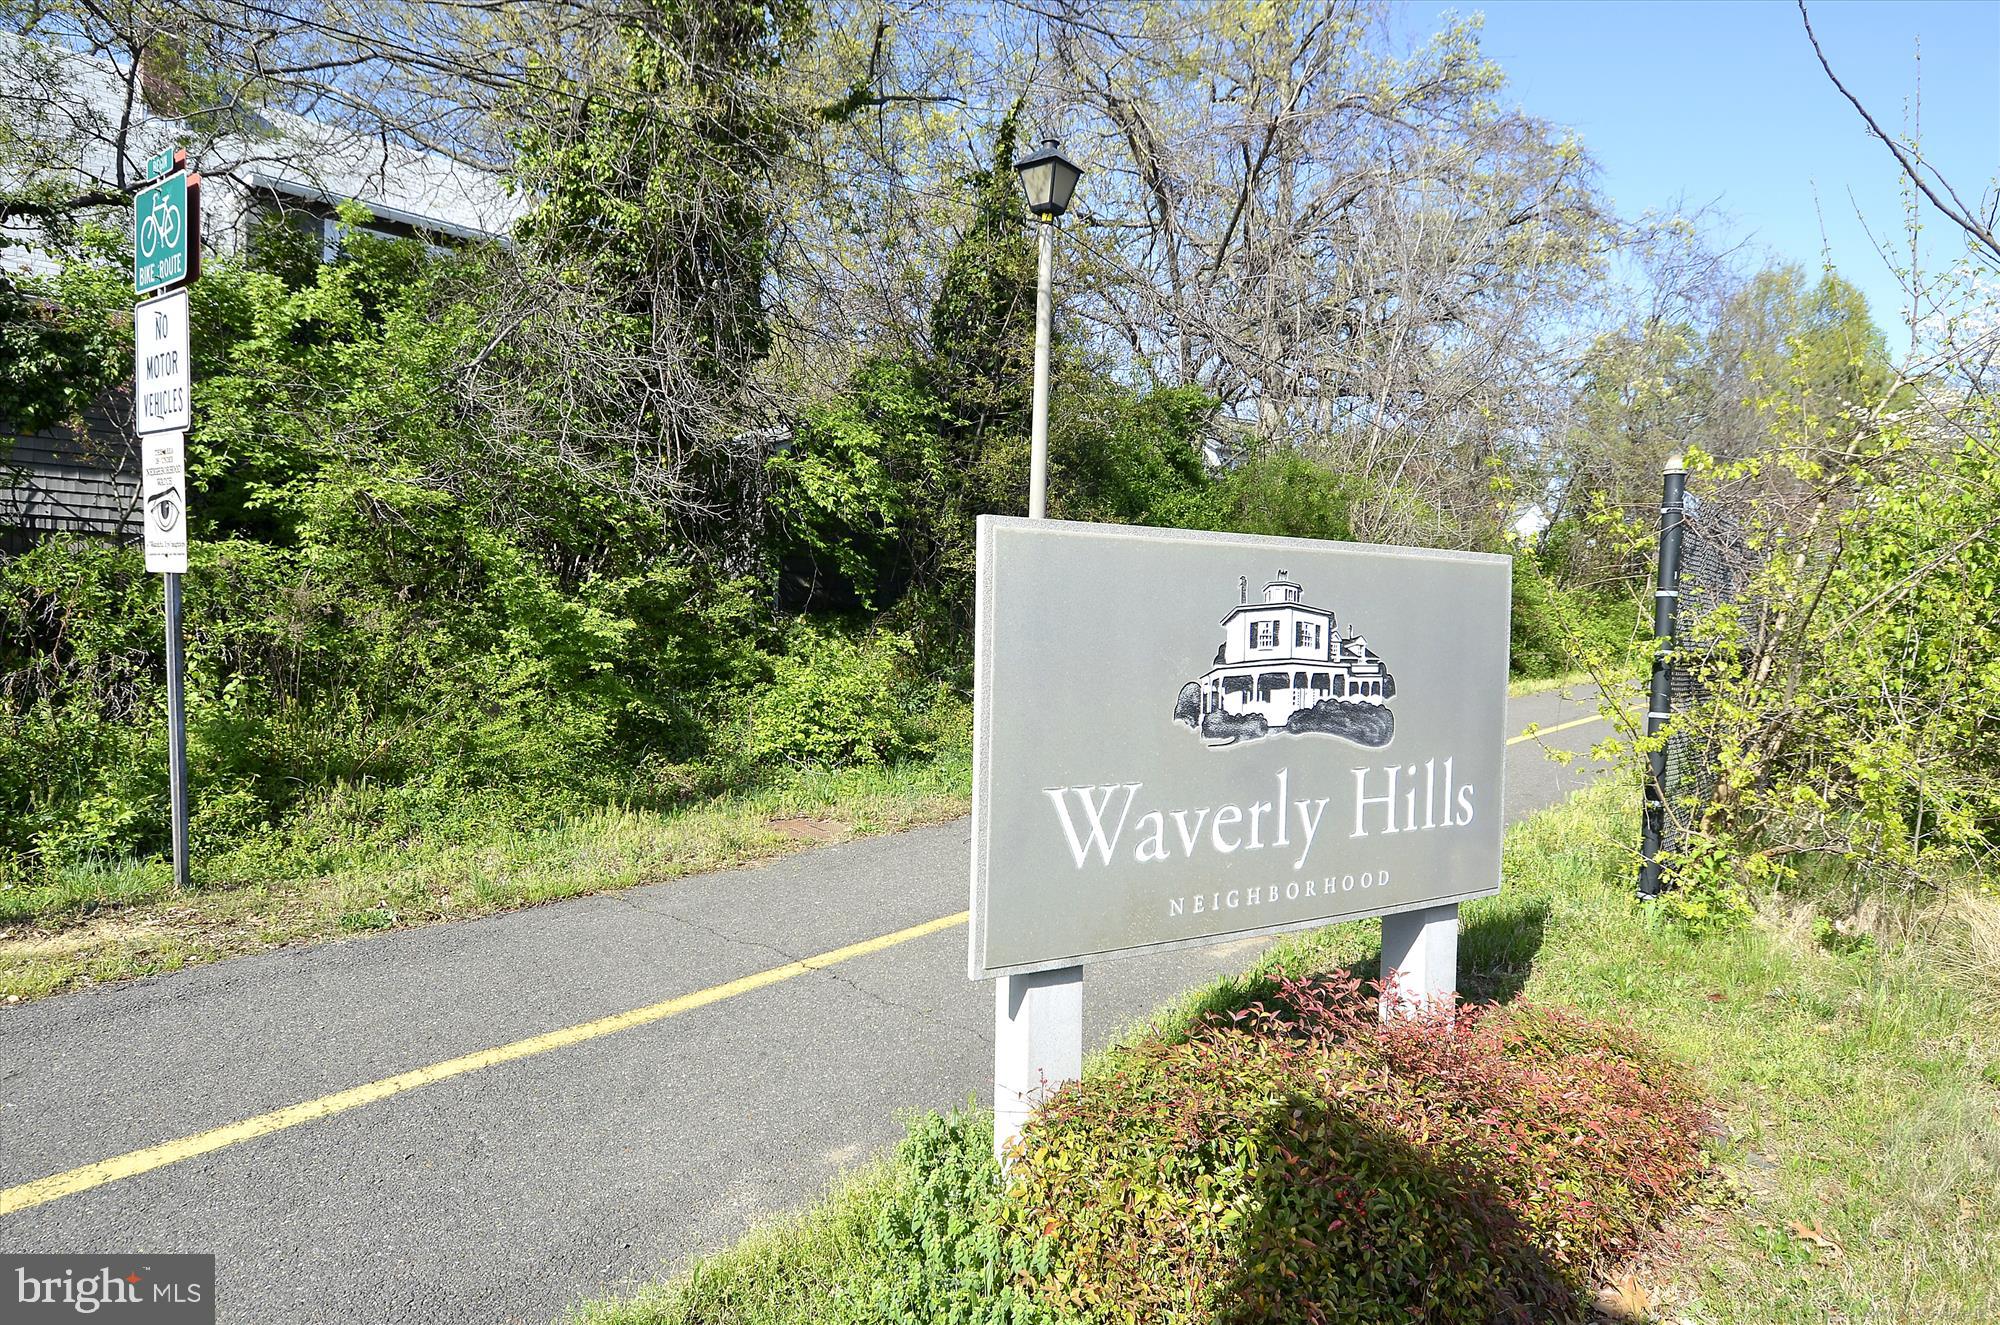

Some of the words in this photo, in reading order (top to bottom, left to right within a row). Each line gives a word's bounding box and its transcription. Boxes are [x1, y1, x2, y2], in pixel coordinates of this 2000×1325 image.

[139, 263, 155, 287] BIKE
[158, 253, 182, 279] ROUTE
[155, 313, 168, 341] NO
[146, 350, 178, 380] MOTOR
[143, 387, 183, 417] VEHICLES
[1043, 767, 1331, 870] Waverly
[1349, 755, 1475, 840] Hills
[1169, 869, 1391, 917] NEIGHBORHOOD
